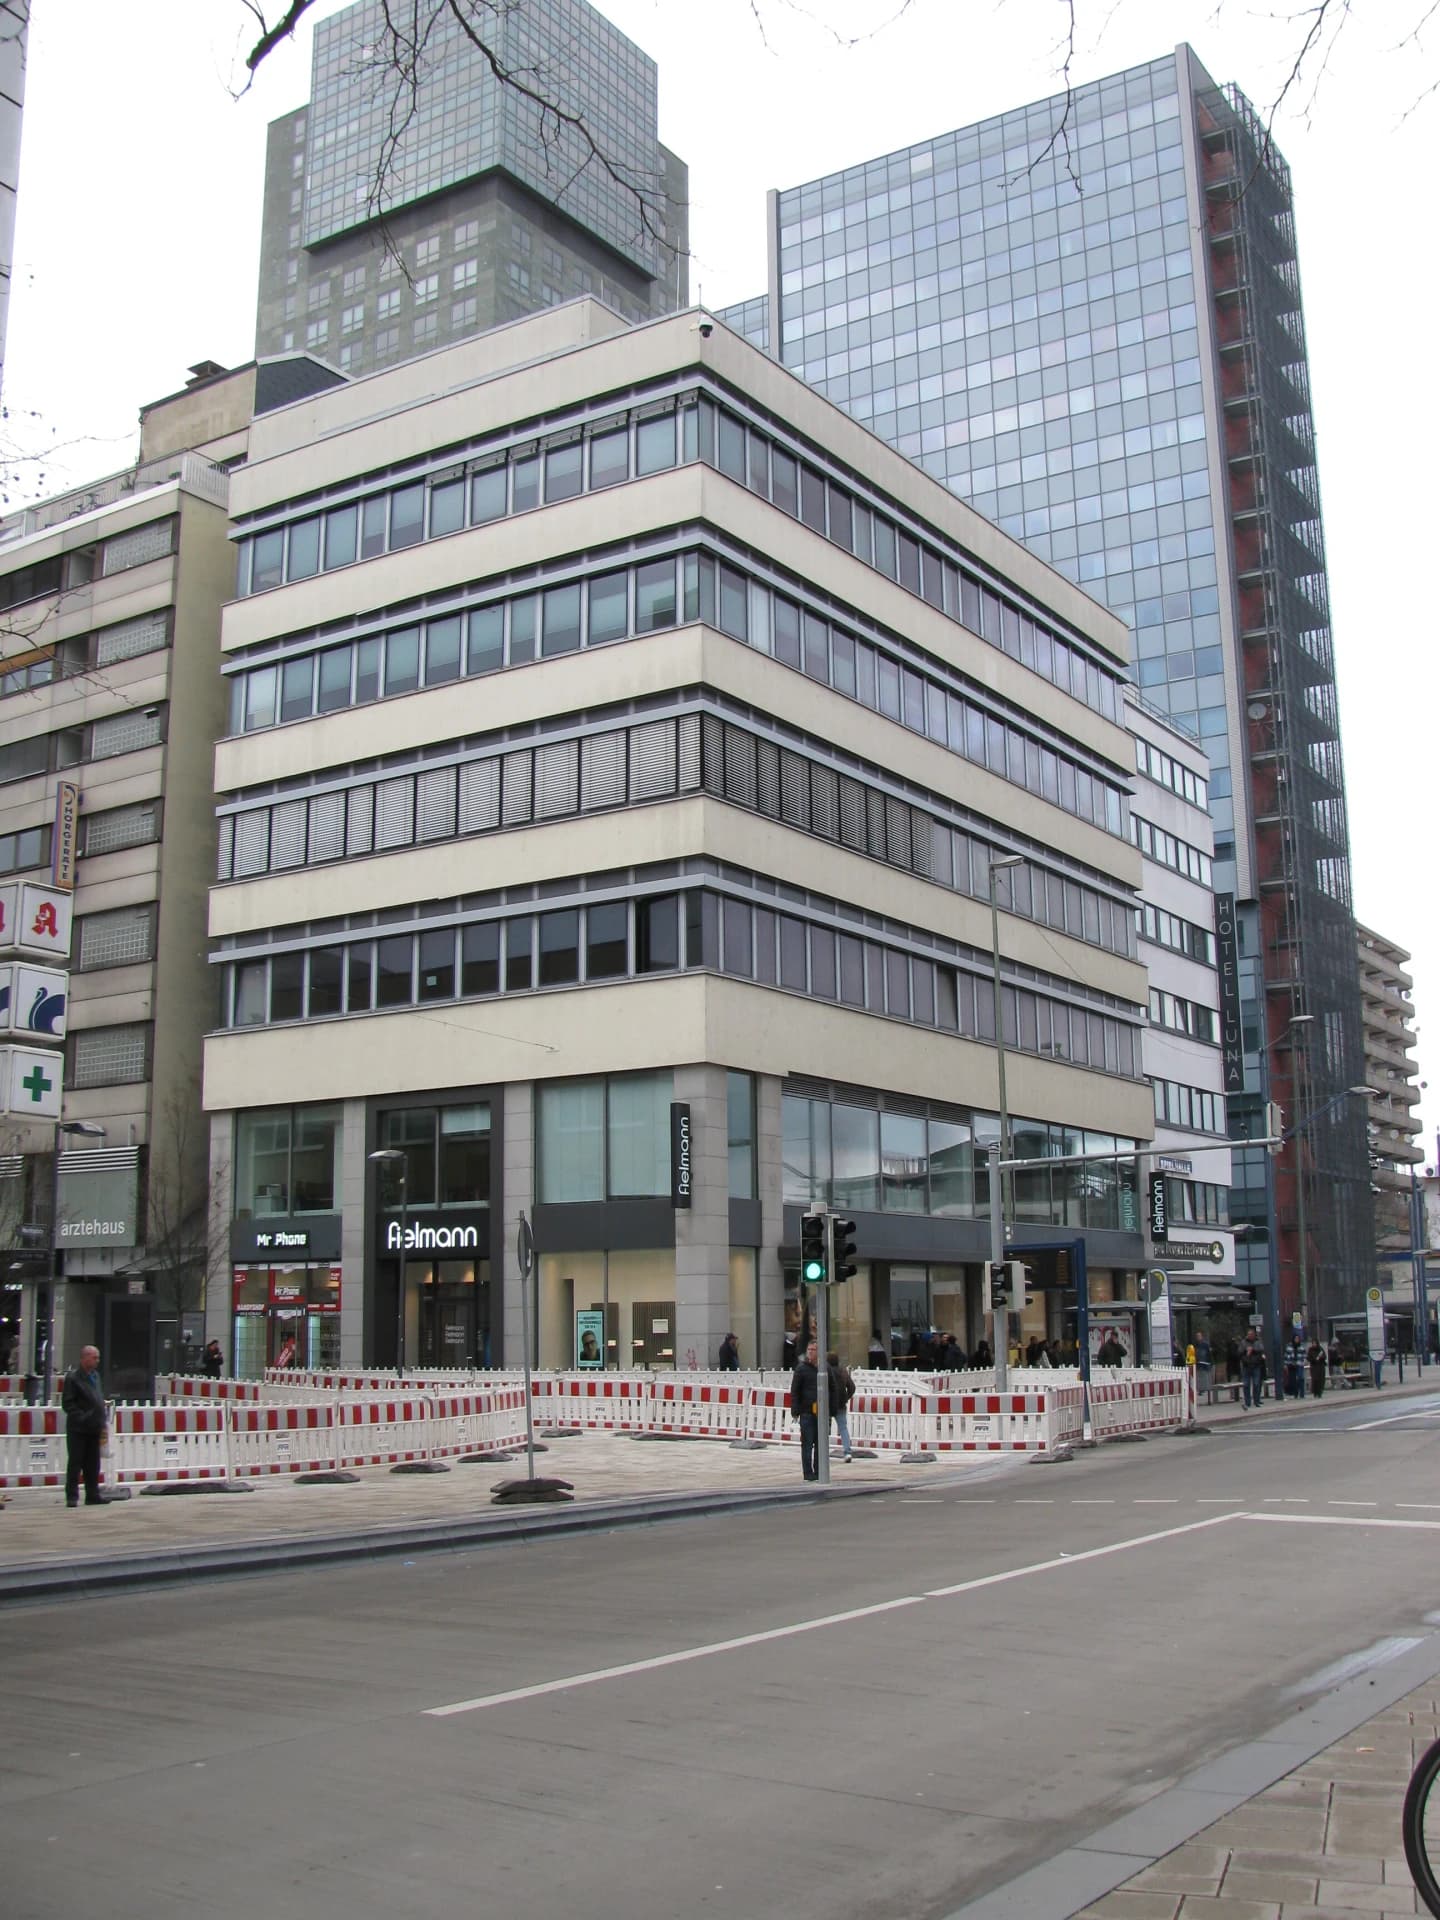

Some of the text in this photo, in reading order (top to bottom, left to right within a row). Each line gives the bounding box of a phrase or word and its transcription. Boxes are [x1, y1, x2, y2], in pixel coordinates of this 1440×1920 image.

[1219, 901, 1240, 1081] HOTEL LUNA
[678, 1116, 690, 1195] fielmann
[1152, 1180, 1165, 1233] fielmann
[257, 1232, 307, 1247] Mr Phone
[387, 1221, 478, 1250] fielmann
